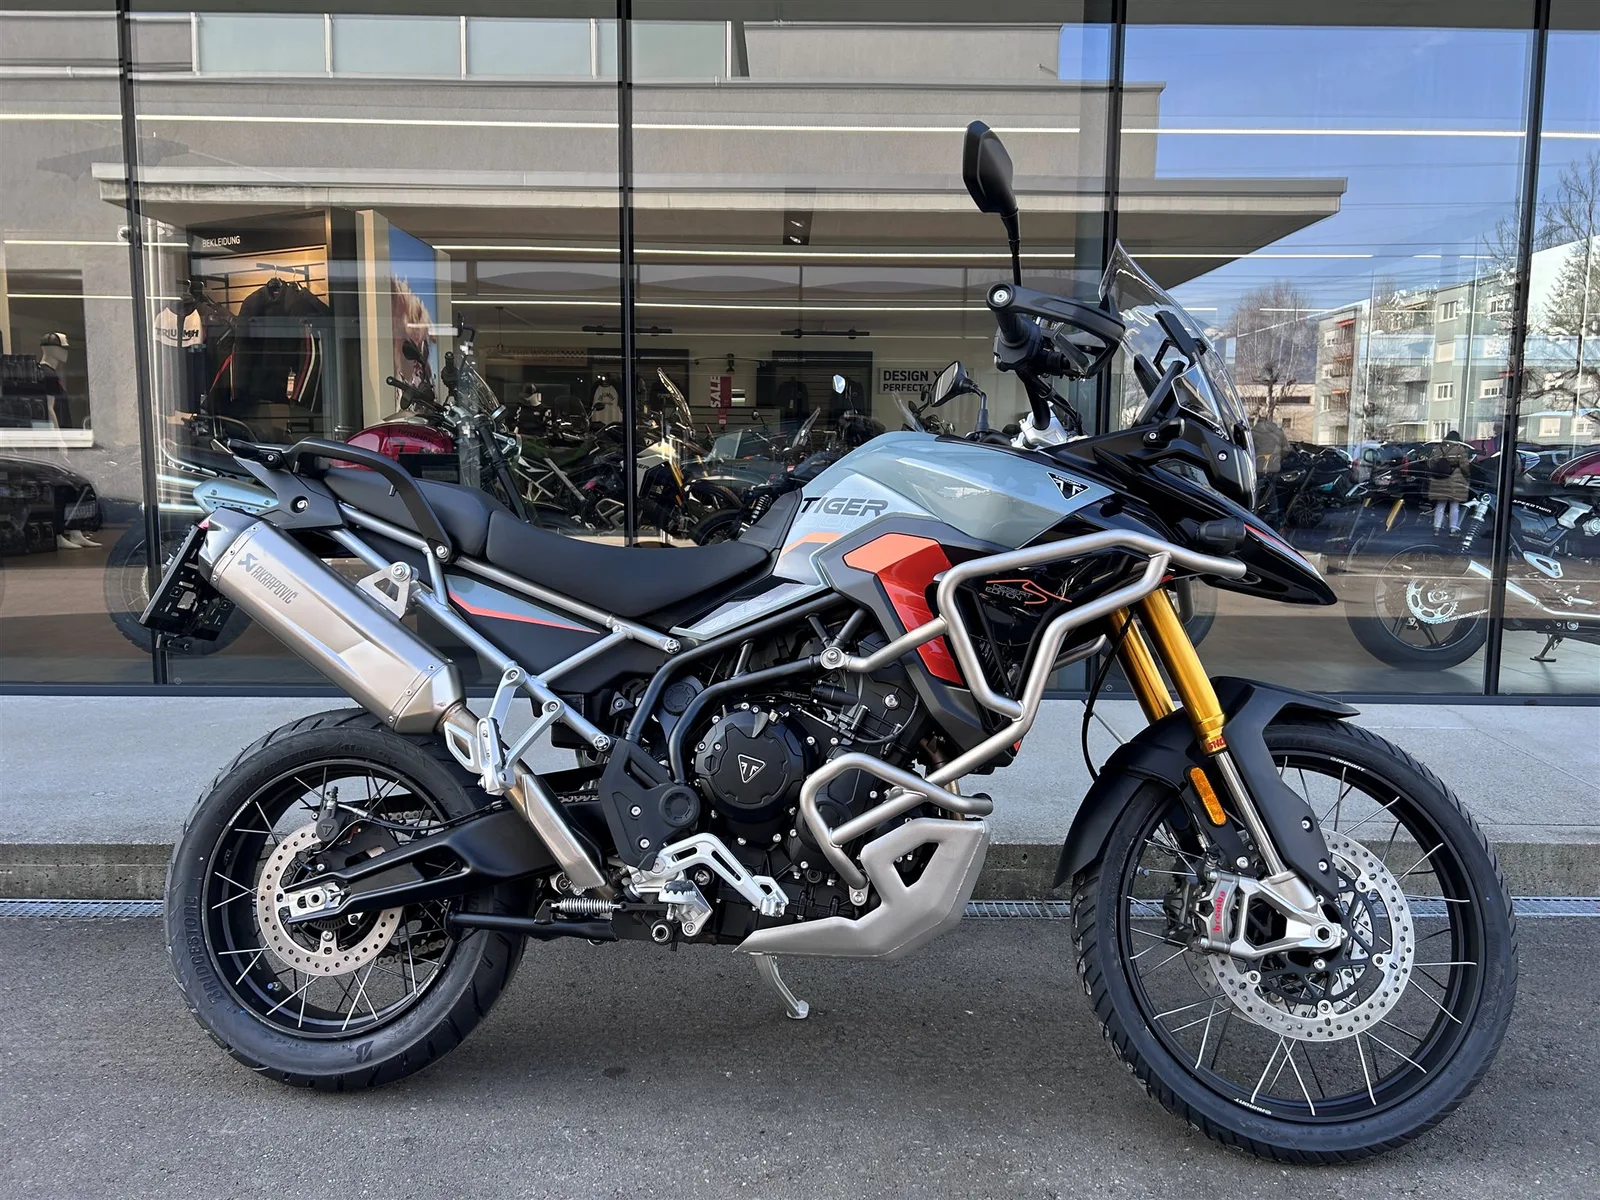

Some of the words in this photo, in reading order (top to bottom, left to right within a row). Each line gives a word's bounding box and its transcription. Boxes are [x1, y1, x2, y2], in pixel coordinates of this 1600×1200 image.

[202, 235, 241, 248] BEKLEIDUNG
[883, 370, 929, 382] DESIGN
[710, 375, 721, 408] SALE
[882, 383, 924, 392] PERFECT
[800, 496, 889, 518] TIGER
[992, 583, 1034, 599] DESERT
[1212, 890, 1226, 933] brembo
[182, 894, 223, 1006] BRIDGESTONE
